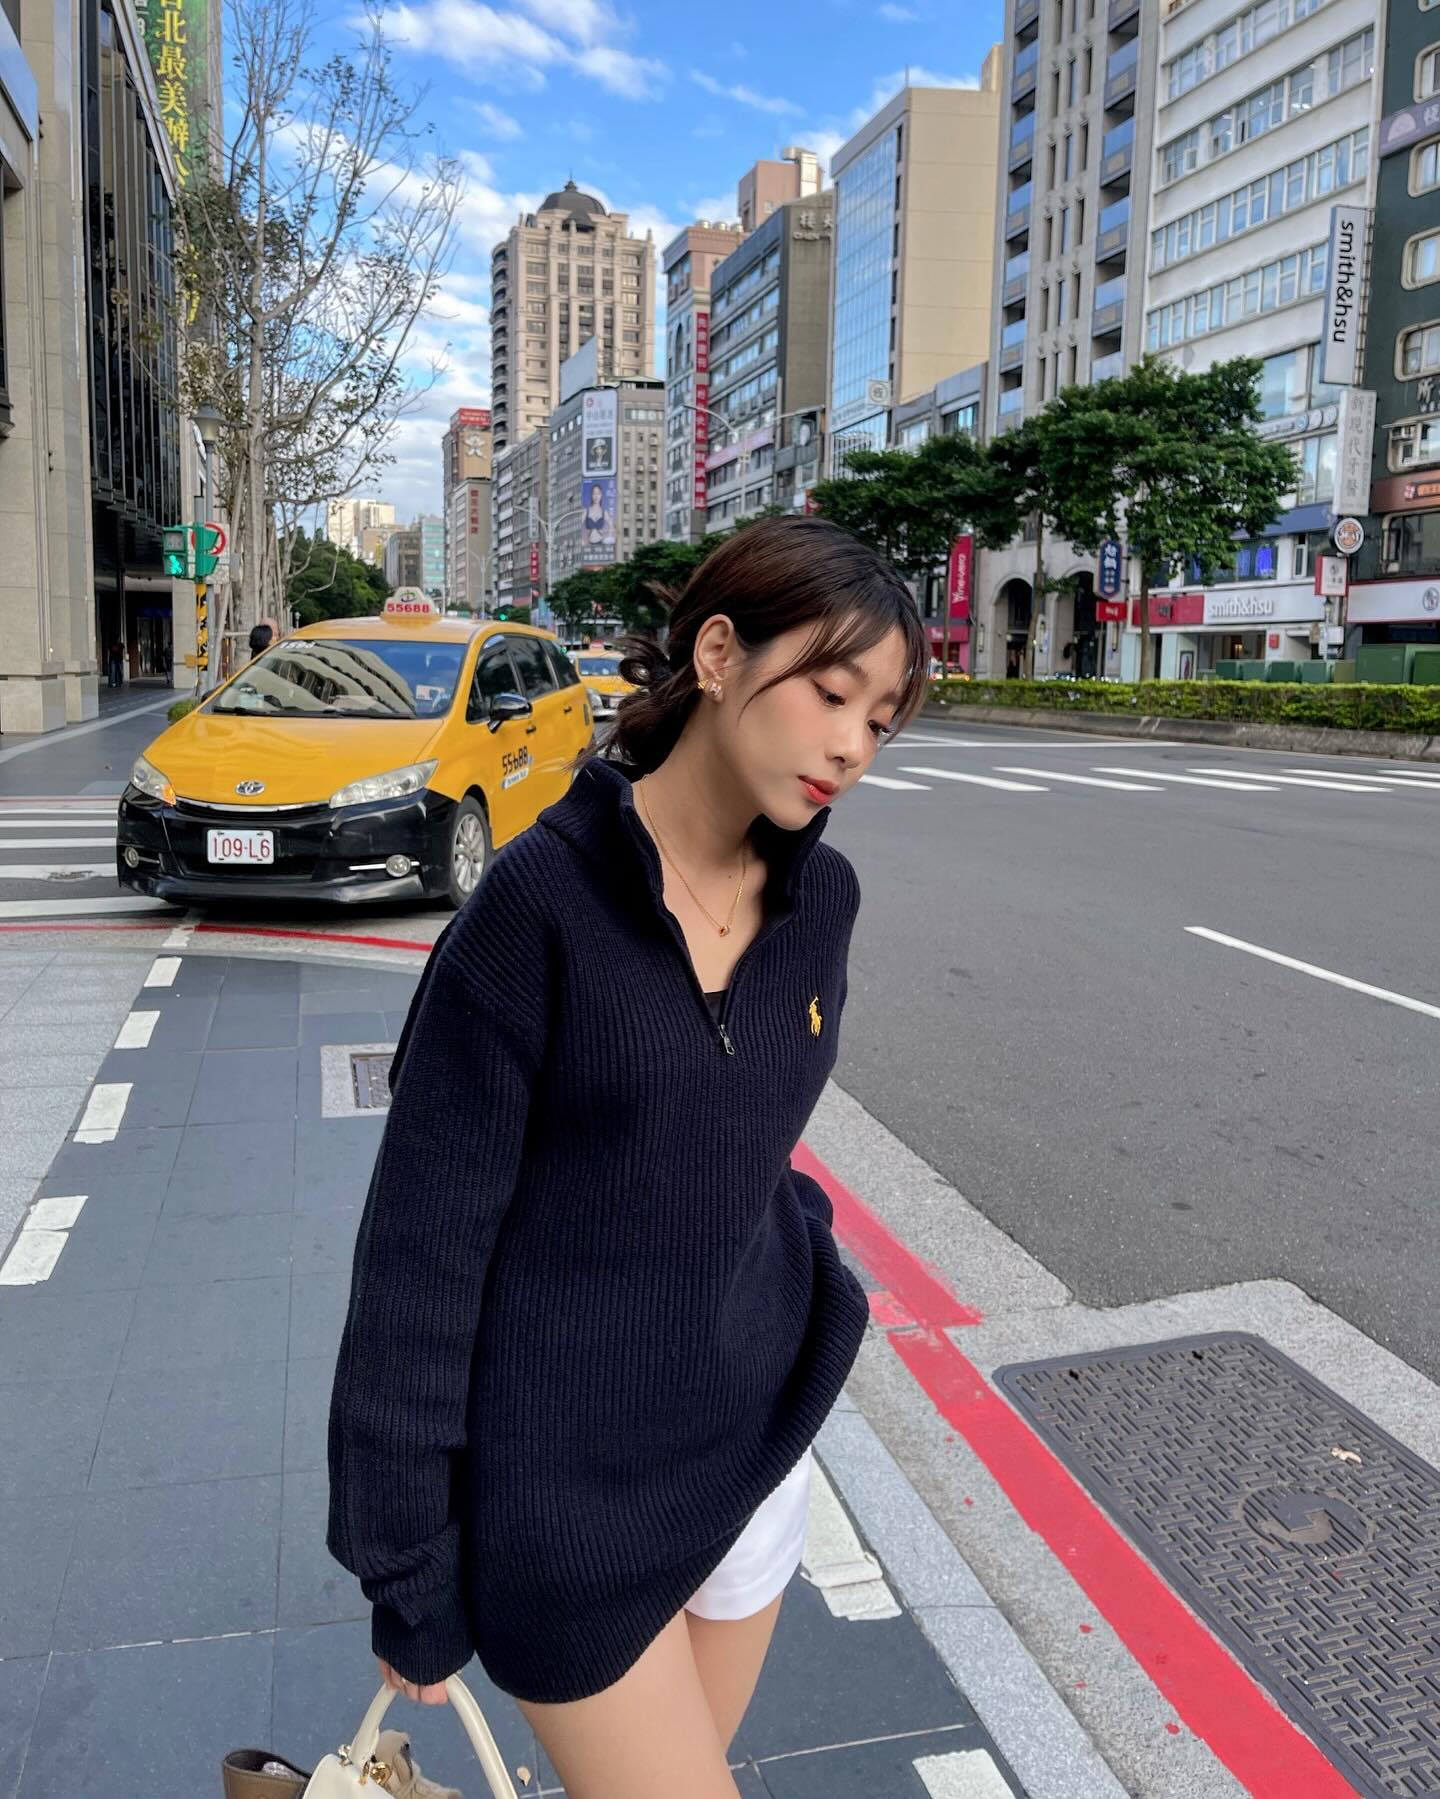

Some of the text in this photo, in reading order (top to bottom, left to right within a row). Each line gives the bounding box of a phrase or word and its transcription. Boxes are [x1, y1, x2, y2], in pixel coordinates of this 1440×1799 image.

[1333, 220, 1356, 343] smith&hsu
[387, 603, 430, 613] 55688
[1209, 597, 1274, 617] smith&hsu
[502, 745, 528, 776] 55688
[213, 837, 270, 858] 109-L6
